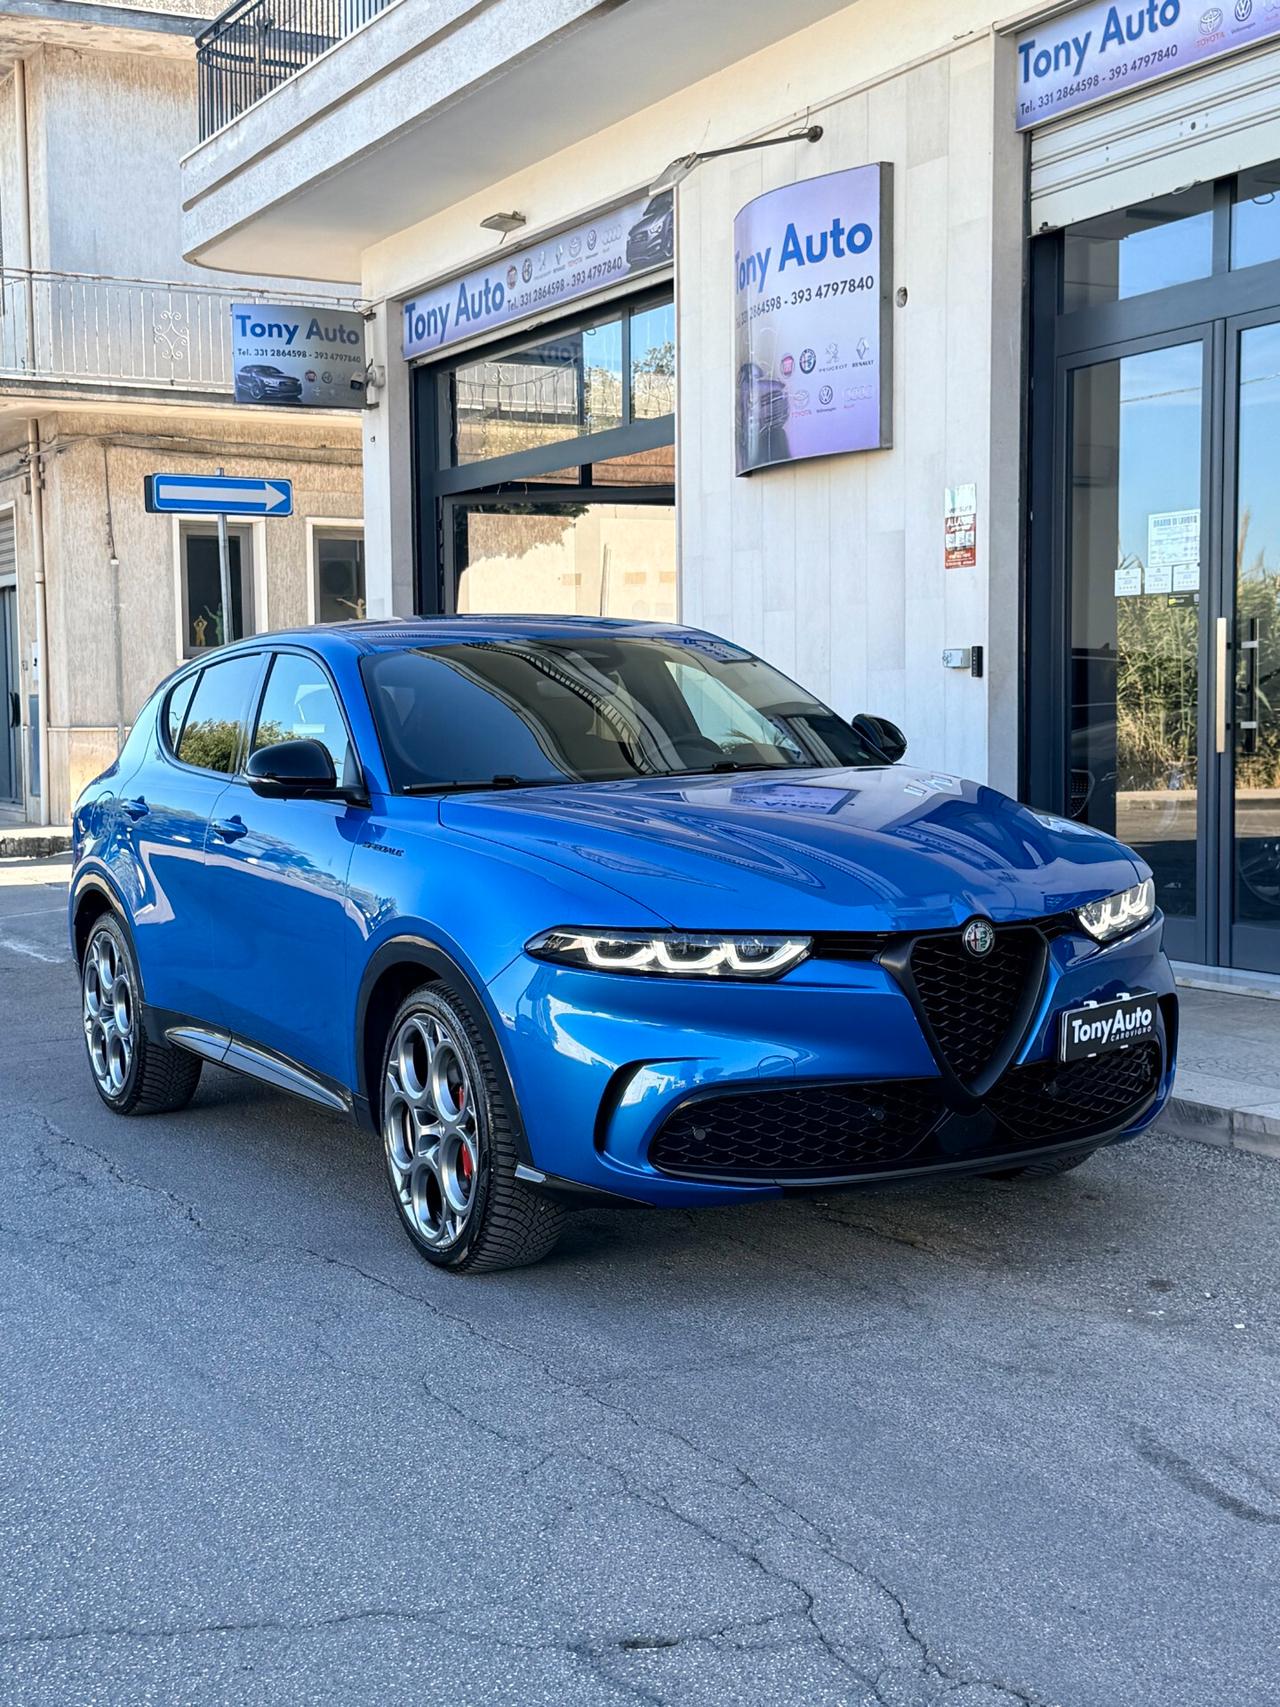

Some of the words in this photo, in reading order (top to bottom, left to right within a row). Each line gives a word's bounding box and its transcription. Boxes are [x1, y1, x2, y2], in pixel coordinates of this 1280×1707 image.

[1018, 31, 1092, 84] Tony
[1099, 0, 1181, 54] Auto
[1020, 99, 1036, 116] Tel.
[1038, 93, 1054, 109] 331
[1056, 74, 1100, 102] 2864598
[1108, 60, 1128, 81] 393
[1130, 44, 1178, 72] 4797840
[520, 292, 532, 307] 331
[533, 279, 565, 302] 2864598
[571, 270, 586, 287] 393
[587, 256, 622, 281] 4797840
[735, 247, 772, 295] Tony
[778, 217, 873, 272] Auto
[405, 302, 450, 344] Tony
[454, 278, 505, 327] Auto
[791, 288, 812, 305] 393
[815, 275, 874, 299] 4797840
[235, 315, 299, 345] Tony
[305, 318, 360, 345] Auto
[238, 348, 252, 357] Tel.
[254, 348, 268, 357] 331
[270, 349, 307, 358] 2864598
[1111, 1025, 1152, 1042] CAROVIGNO
